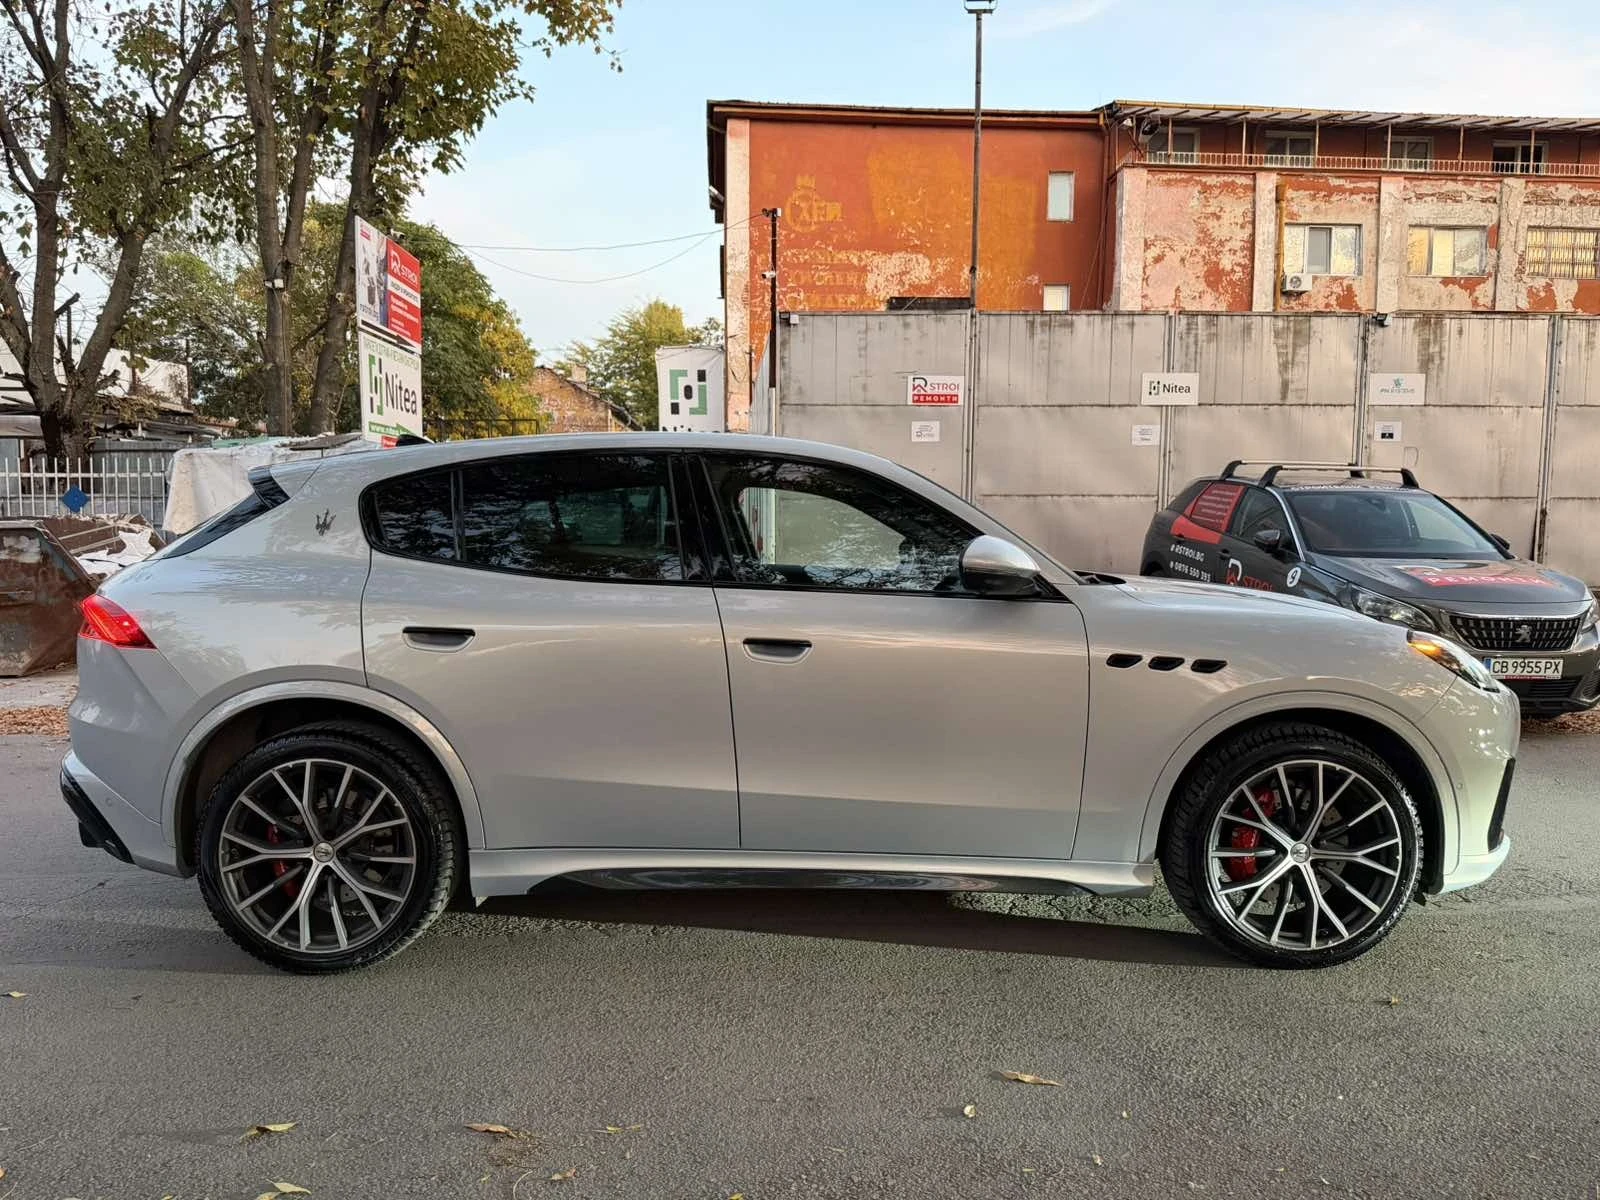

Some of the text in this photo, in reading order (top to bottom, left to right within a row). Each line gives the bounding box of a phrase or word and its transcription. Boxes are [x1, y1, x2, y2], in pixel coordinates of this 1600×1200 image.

[385, 371, 417, 415] Nitea
[1162, 383, 1191, 393] Nitea
[1289, 570, 1298, 584] 9
[1492, 660, 1561, 674] CB 9955 PX
